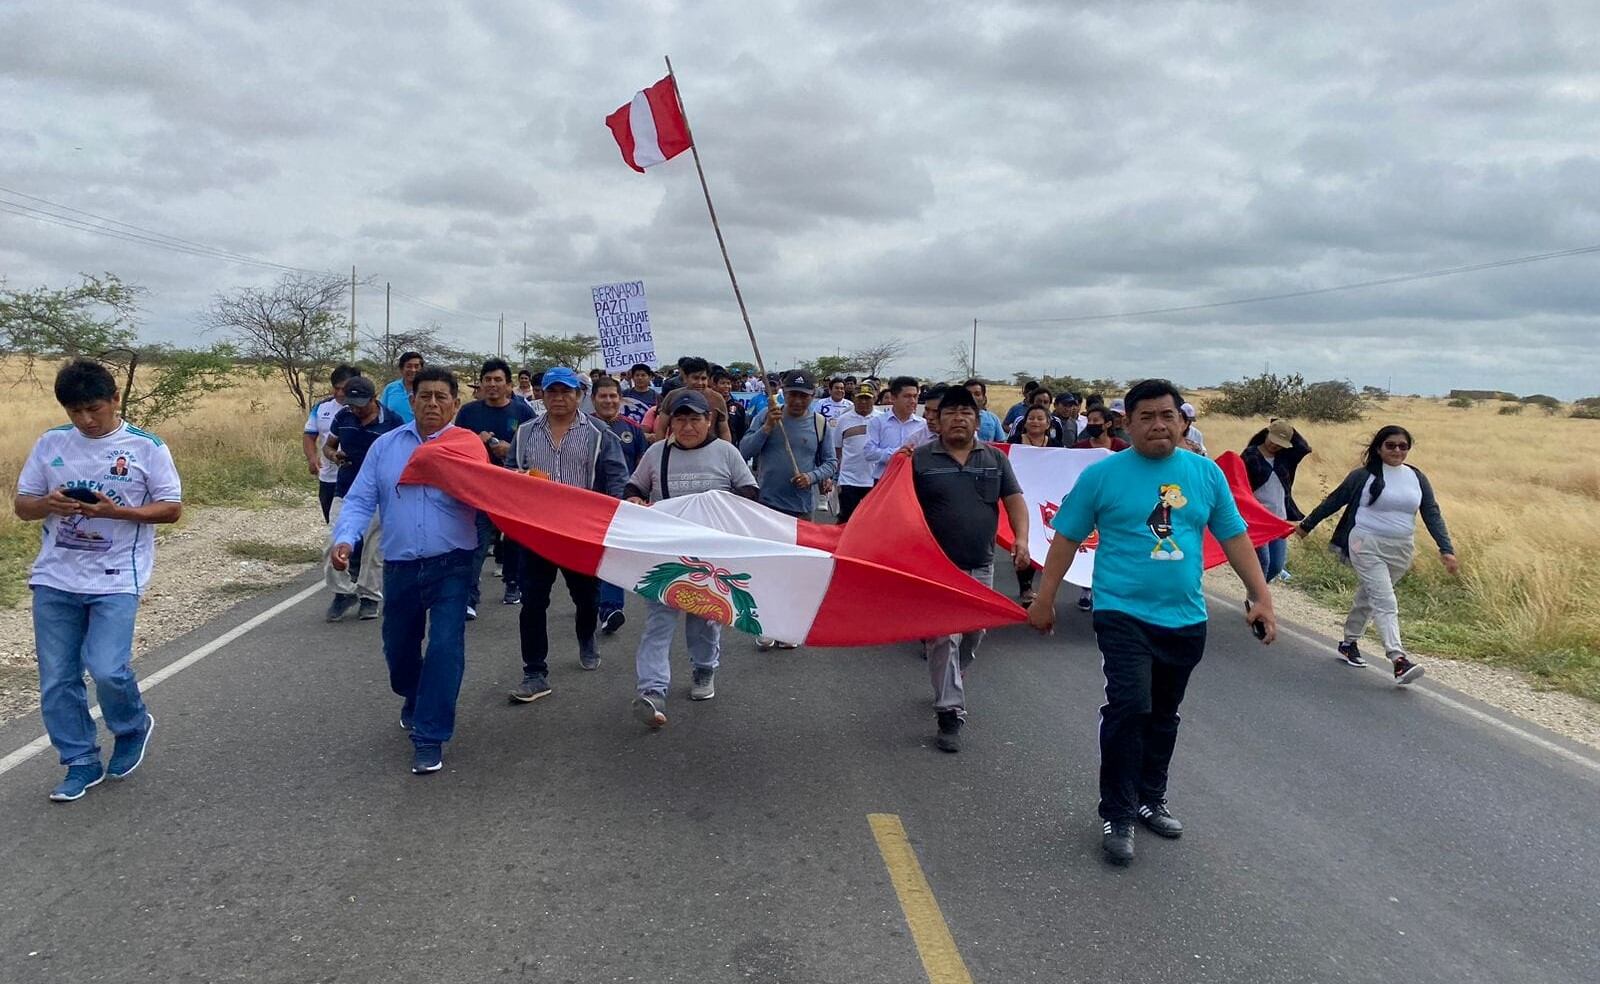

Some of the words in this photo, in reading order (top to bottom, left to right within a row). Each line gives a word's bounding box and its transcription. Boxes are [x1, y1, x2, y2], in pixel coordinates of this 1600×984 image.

[592, 281, 644, 301] BERNARDO
[594, 299, 628, 317] PAZO
[598, 311, 649, 328] ACUERDATE
[603, 347, 621, 358] LOS
[605, 352, 656, 368] PESCADORES
